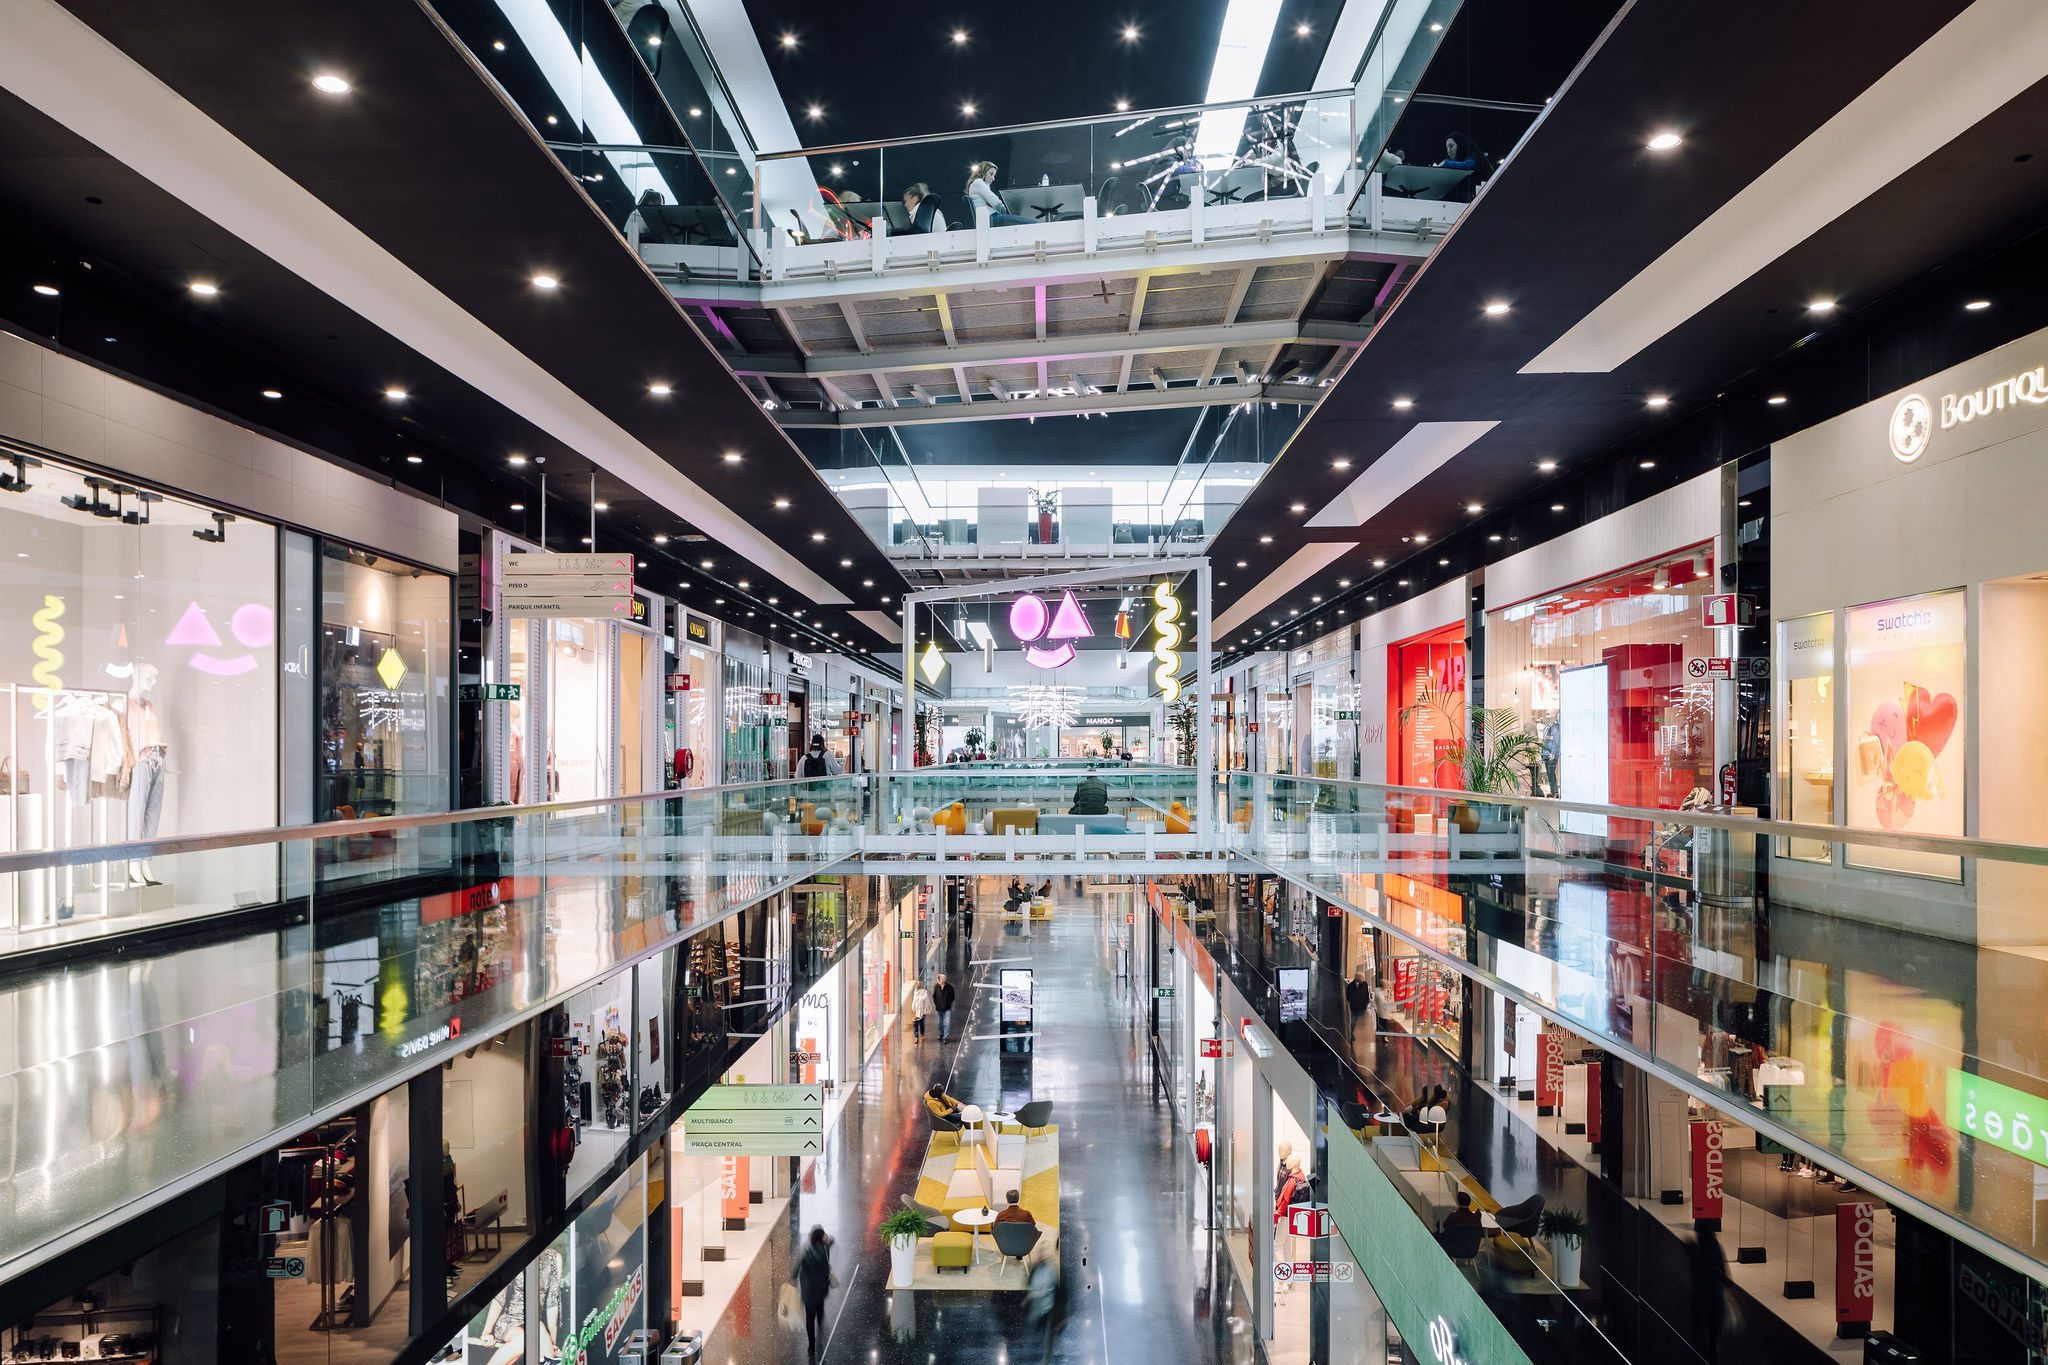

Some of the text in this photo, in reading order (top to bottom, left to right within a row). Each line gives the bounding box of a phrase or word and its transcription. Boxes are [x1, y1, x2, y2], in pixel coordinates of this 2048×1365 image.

[1877, 611, 1922, 631] swatch
[1793, 638, 1820, 650] swatch
[1086, 717, 1114, 725] MANGO
[691, 1141, 713, 1149] PRAÇA
[606, 1273, 641, 1349] SALDOS
